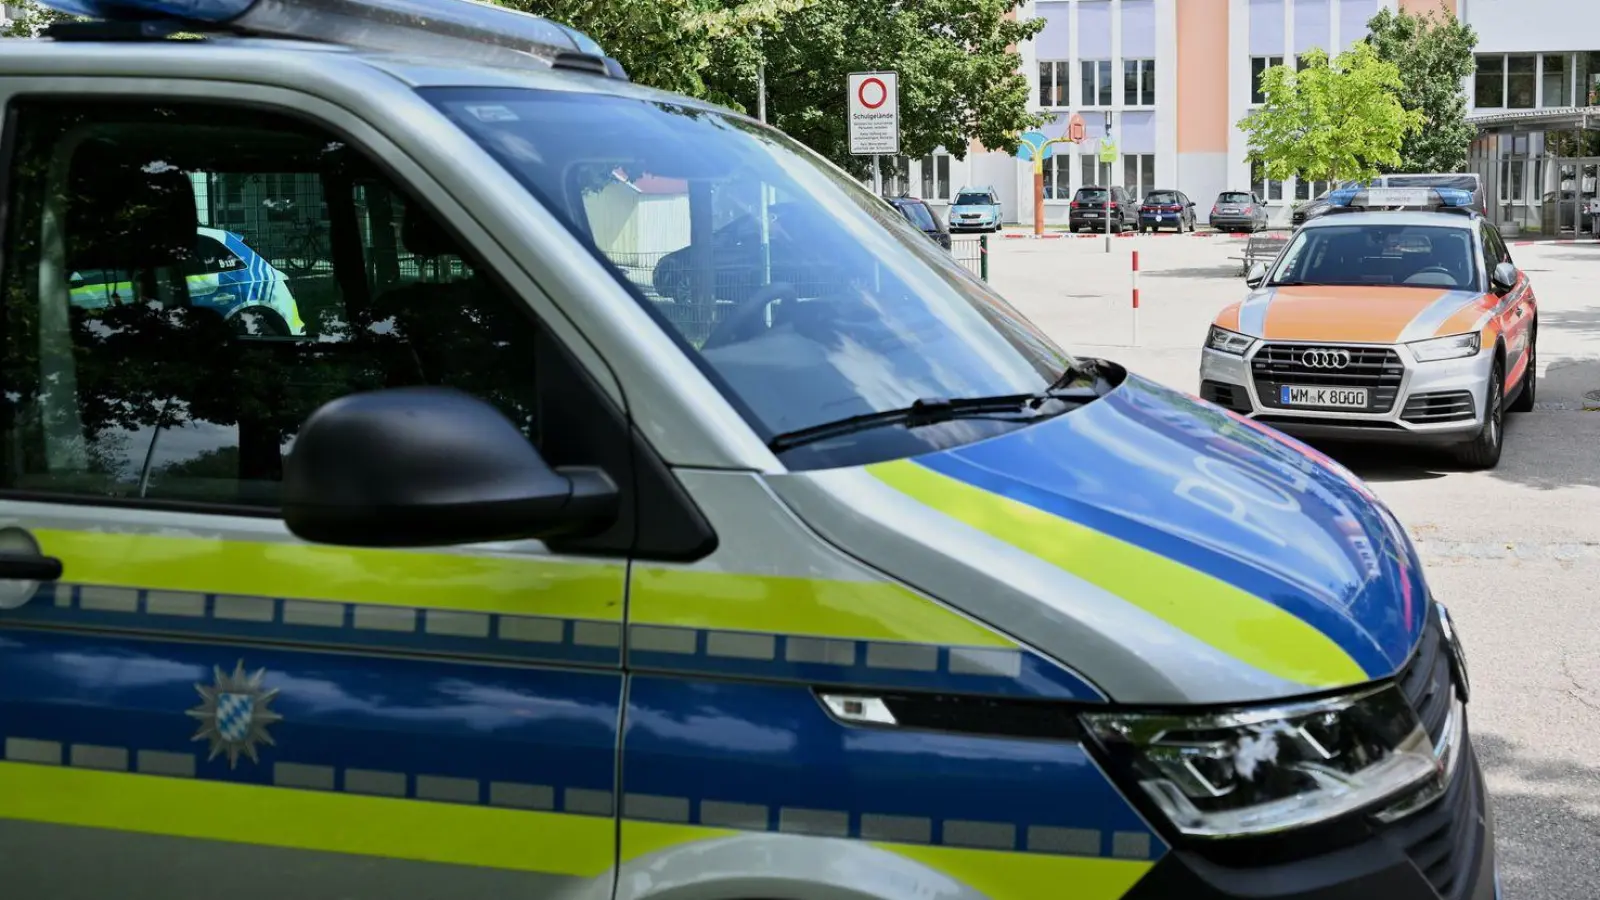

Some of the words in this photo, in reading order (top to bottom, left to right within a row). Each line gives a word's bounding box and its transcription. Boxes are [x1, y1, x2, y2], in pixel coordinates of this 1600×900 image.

[1290, 388, 1308, 402] WM
[1317, 390, 1326, 403] K
[1330, 391, 1364, 405] 8000
